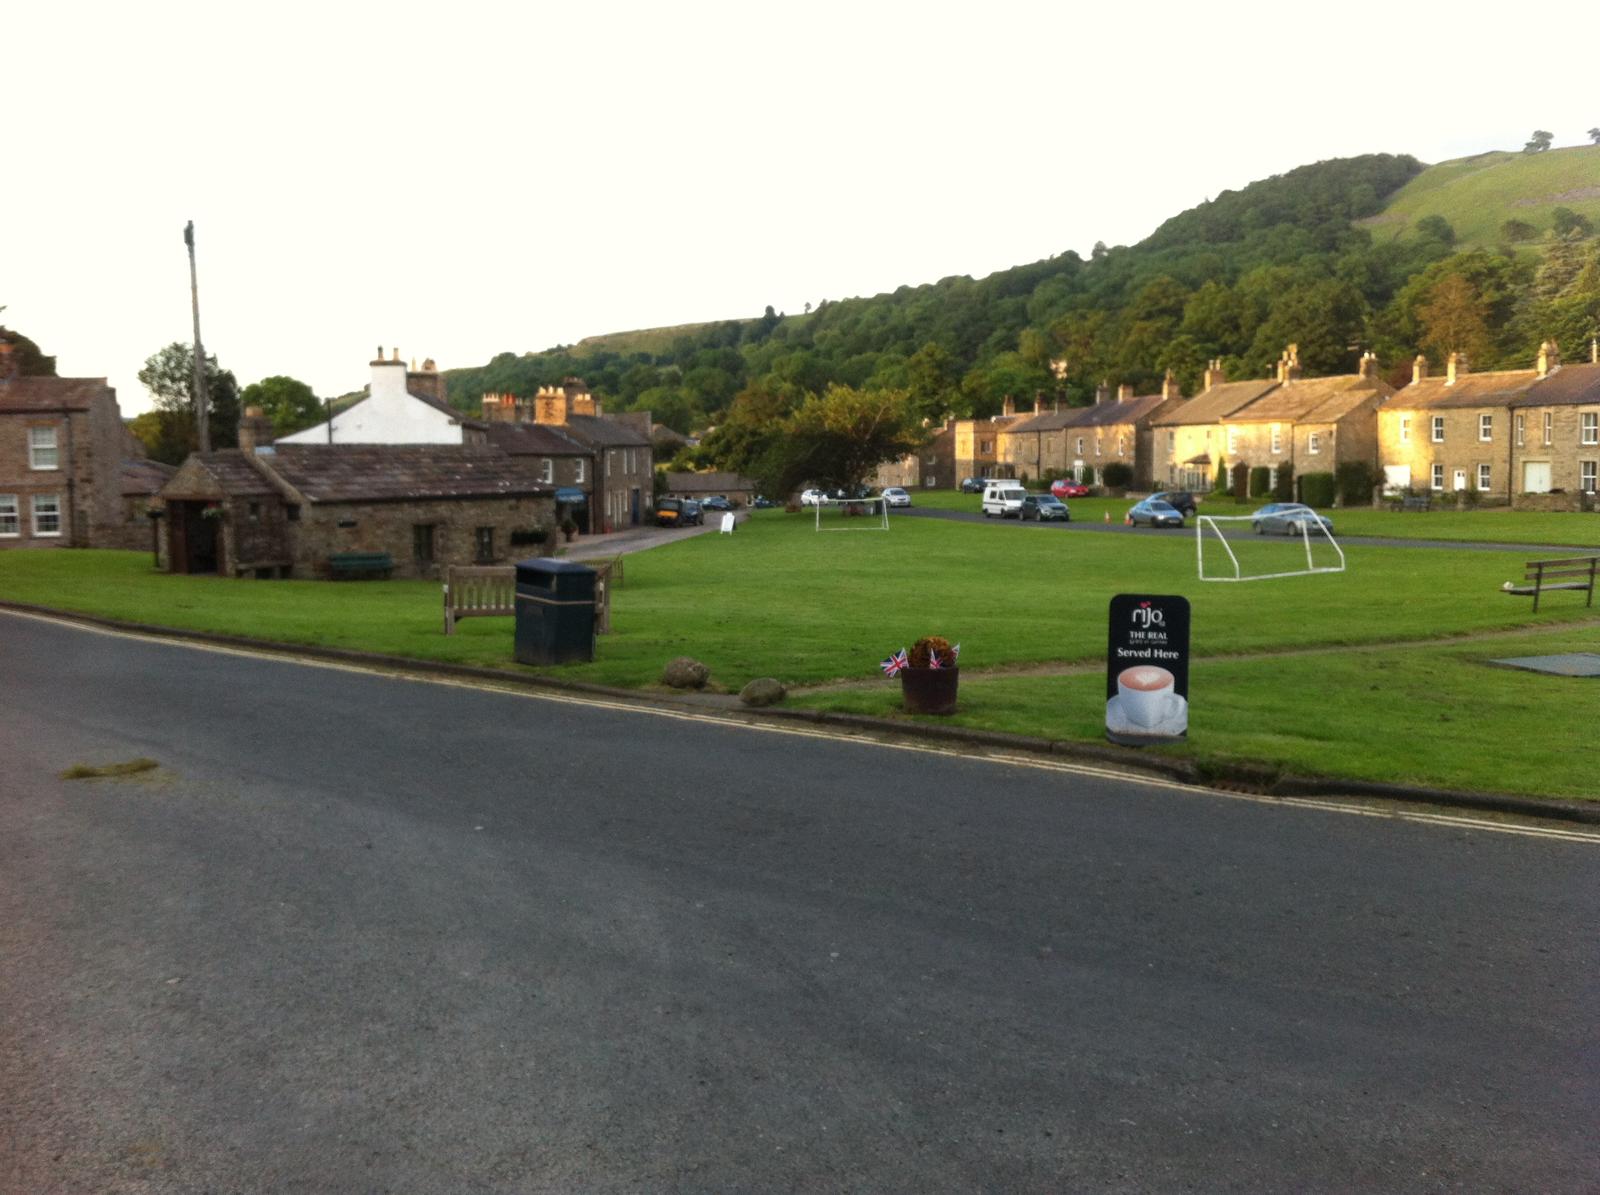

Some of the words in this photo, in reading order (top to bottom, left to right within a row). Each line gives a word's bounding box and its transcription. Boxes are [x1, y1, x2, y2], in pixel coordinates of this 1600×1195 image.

[1129, 631, 1146, 639] THE
[1147, 631, 1168, 640] REAL
[1117, 647, 1152, 658] Served
[1153, 648, 1180, 659] Here
